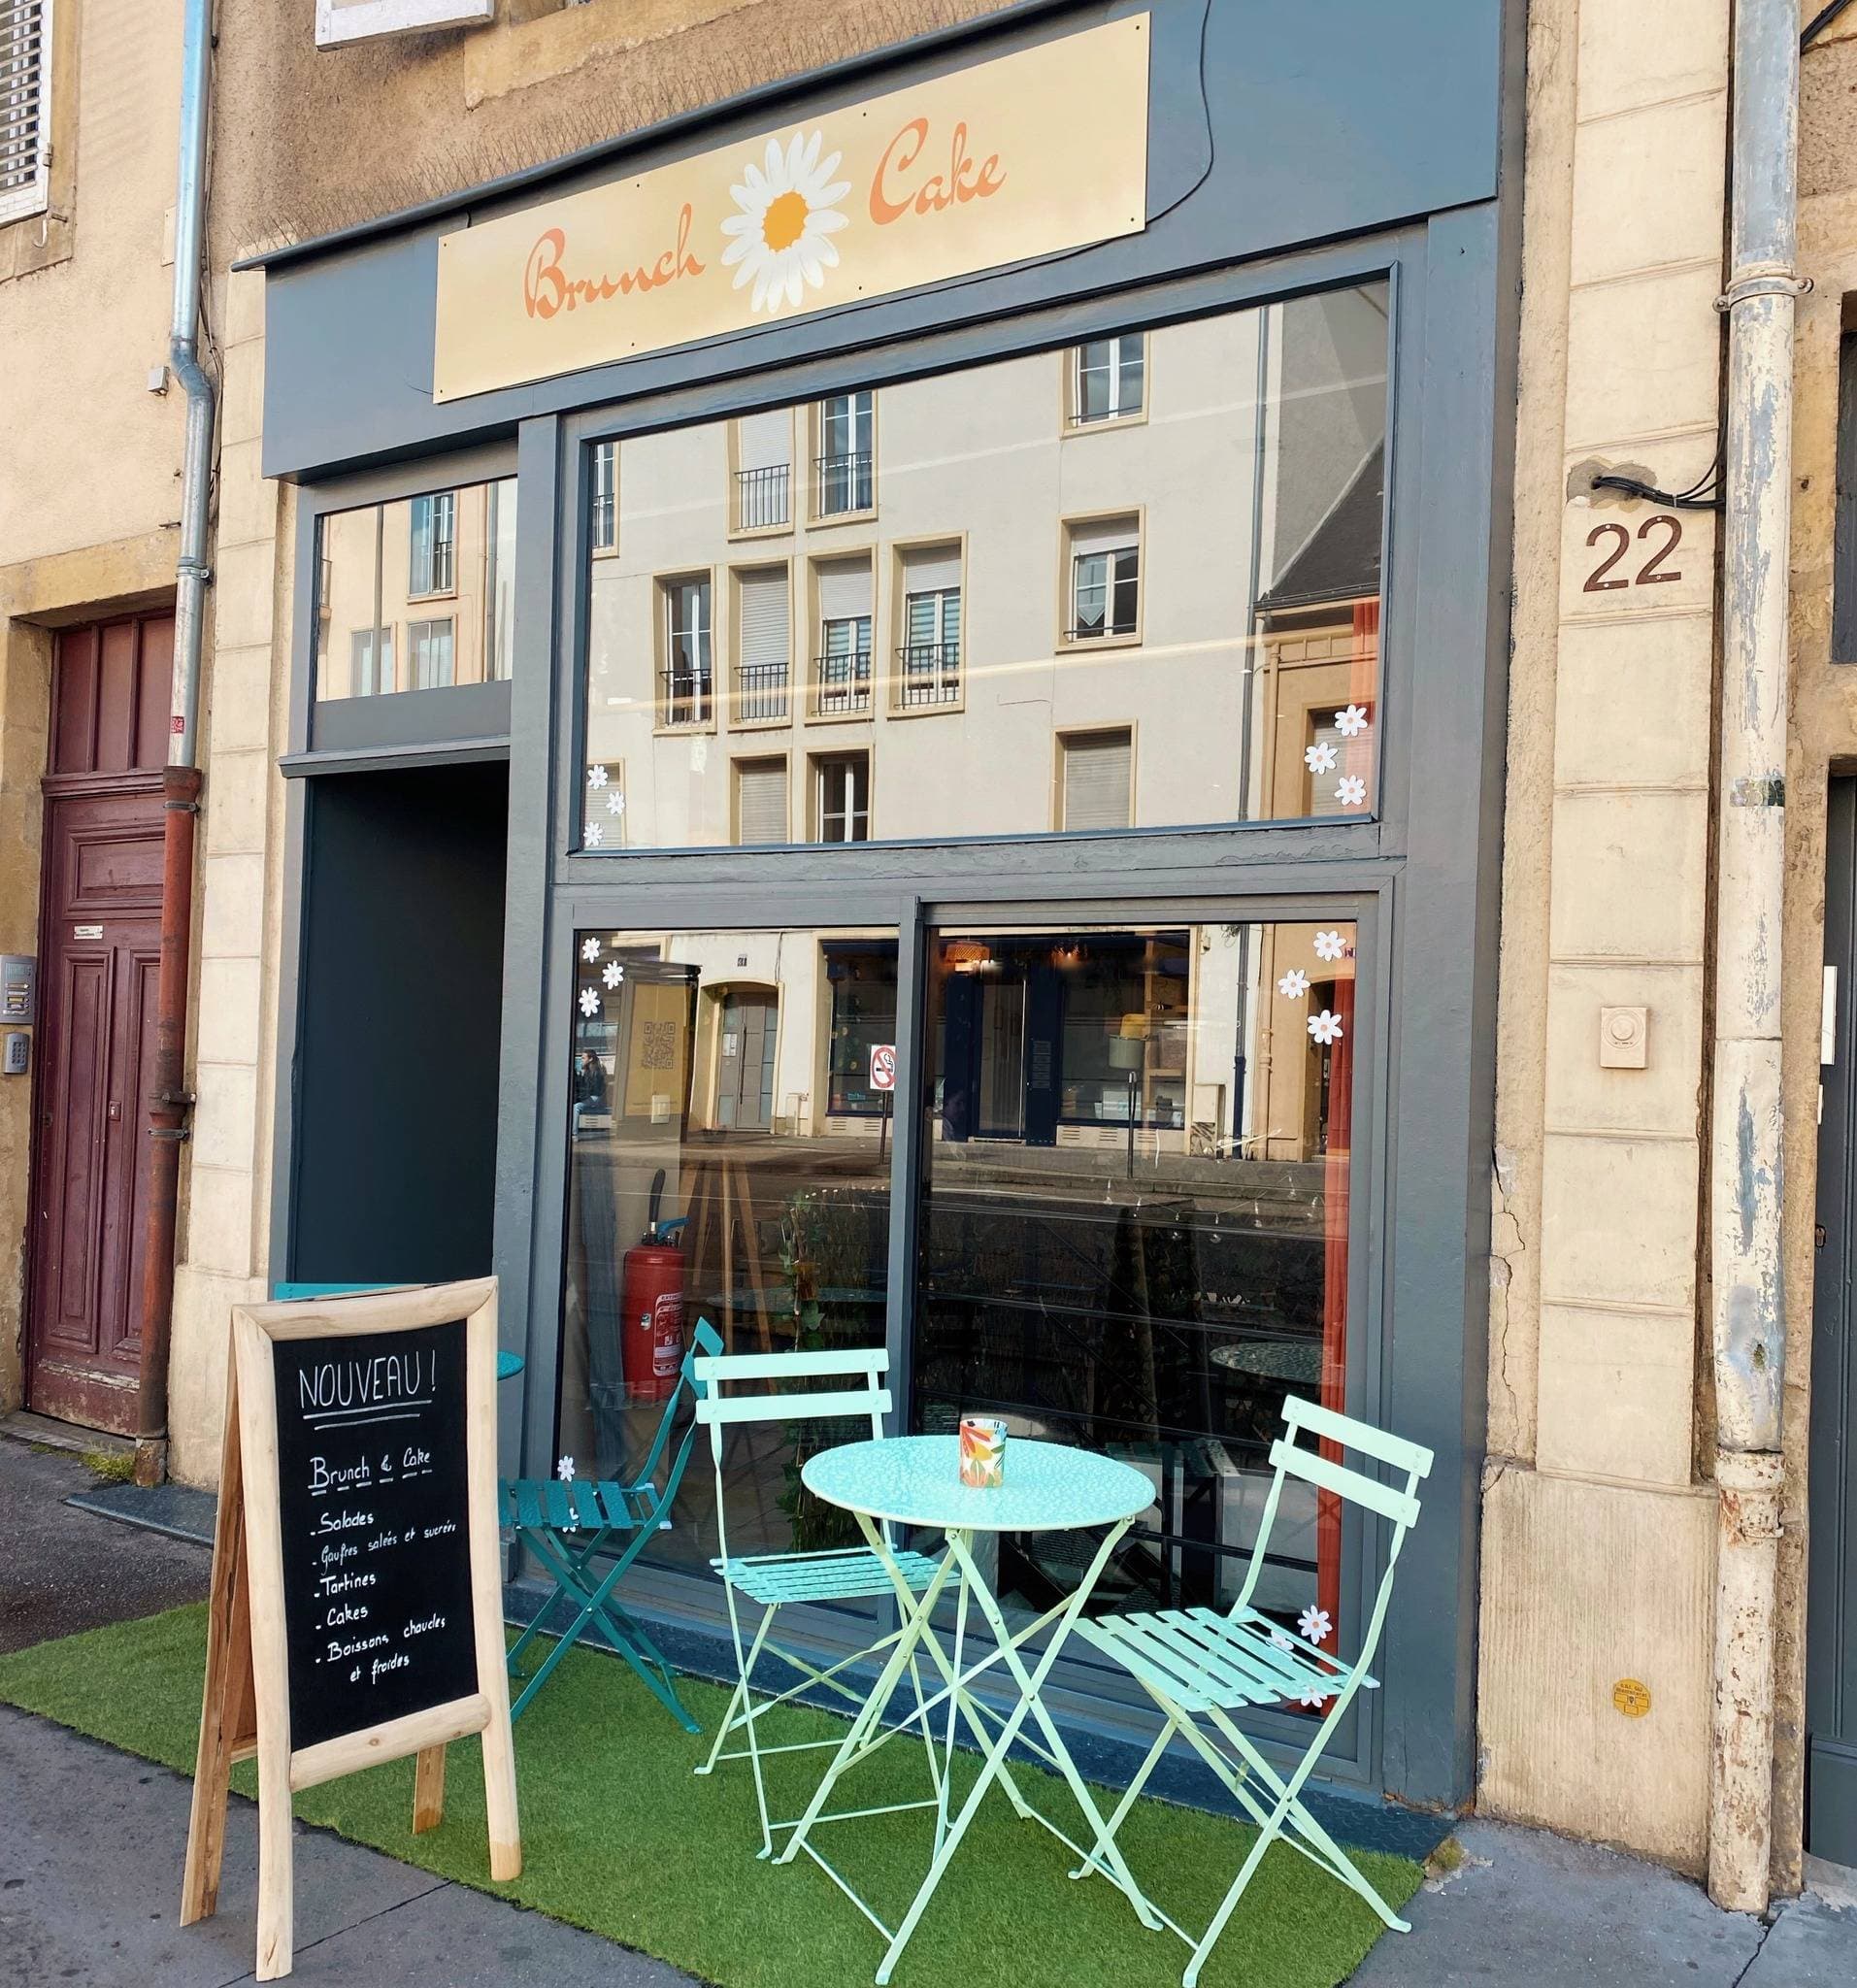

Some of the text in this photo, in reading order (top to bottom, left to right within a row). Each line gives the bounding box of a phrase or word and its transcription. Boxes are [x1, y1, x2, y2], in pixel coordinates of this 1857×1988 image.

[524, 117, 1007, 319] Brunch Cake
[1583, 514, 1682, 592] 22
[299, 1350, 420, 1409] NOUVEAU
[308, 1455, 370, 1489] Brunch
[403, 1447, 431, 1468] Cake
[404, 1526, 415, 1542] et
[403, 1612, 446, 1638] chaudes
[349, 1652, 410, 1685] et froides
